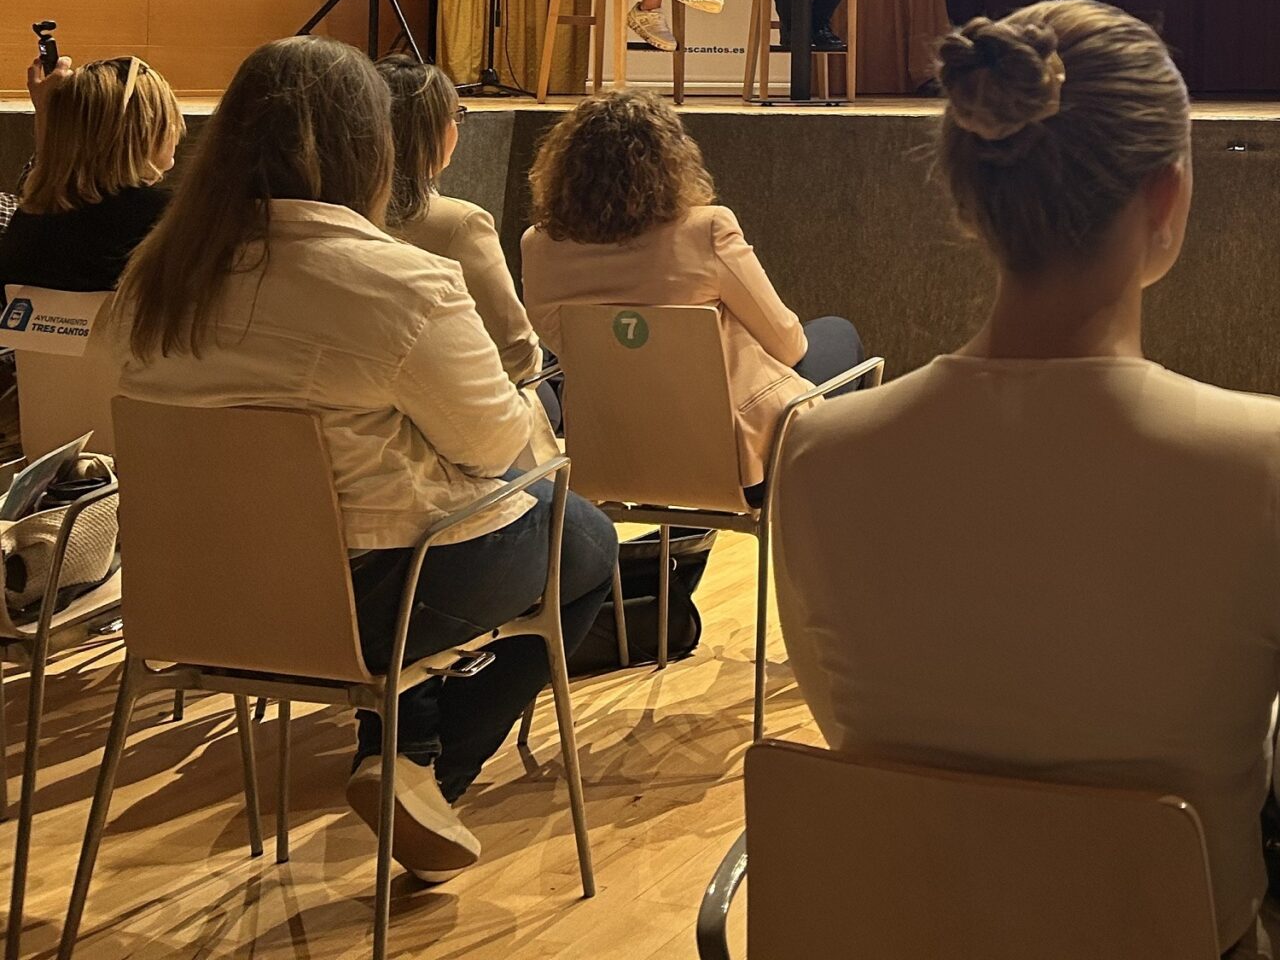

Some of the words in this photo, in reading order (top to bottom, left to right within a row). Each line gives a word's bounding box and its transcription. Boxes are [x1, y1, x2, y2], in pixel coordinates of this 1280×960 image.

[34, 314, 88, 326] AYUNTAMIENTO
[31, 323, 56, 334] TRES
[57, 326, 90, 337] CANTOS
[620, 317, 638, 340] 7
